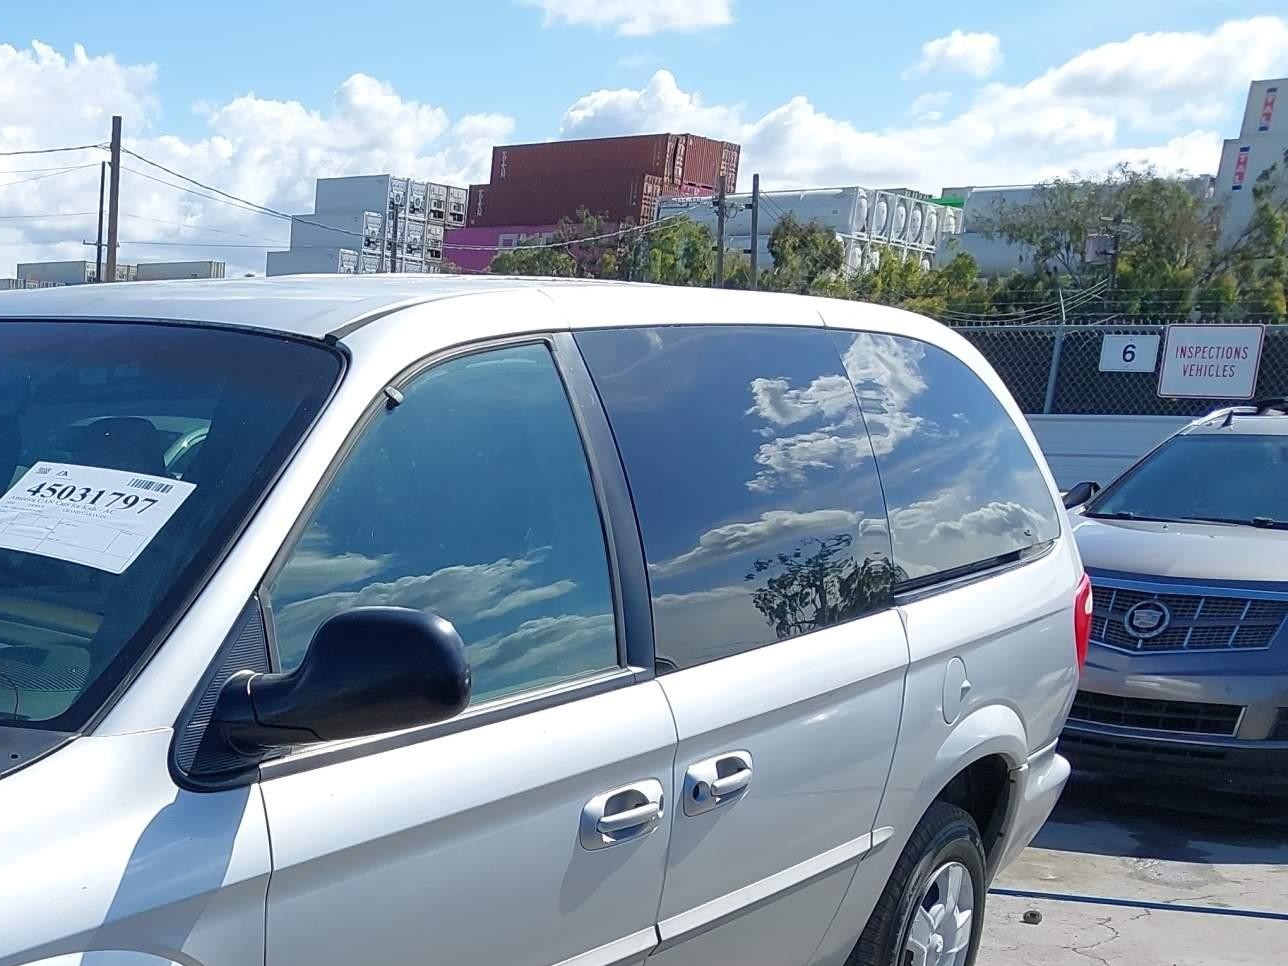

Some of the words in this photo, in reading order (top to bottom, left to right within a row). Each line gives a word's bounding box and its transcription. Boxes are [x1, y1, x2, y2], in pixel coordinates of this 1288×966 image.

[1122, 344, 1137, 363] 6
[1175, 346, 1249, 360] INSPECTIONS
[1182, 364, 1236, 378] VEHICLES
[9, 495, 37, 504] America
[27, 481, 159, 514] 45031797
